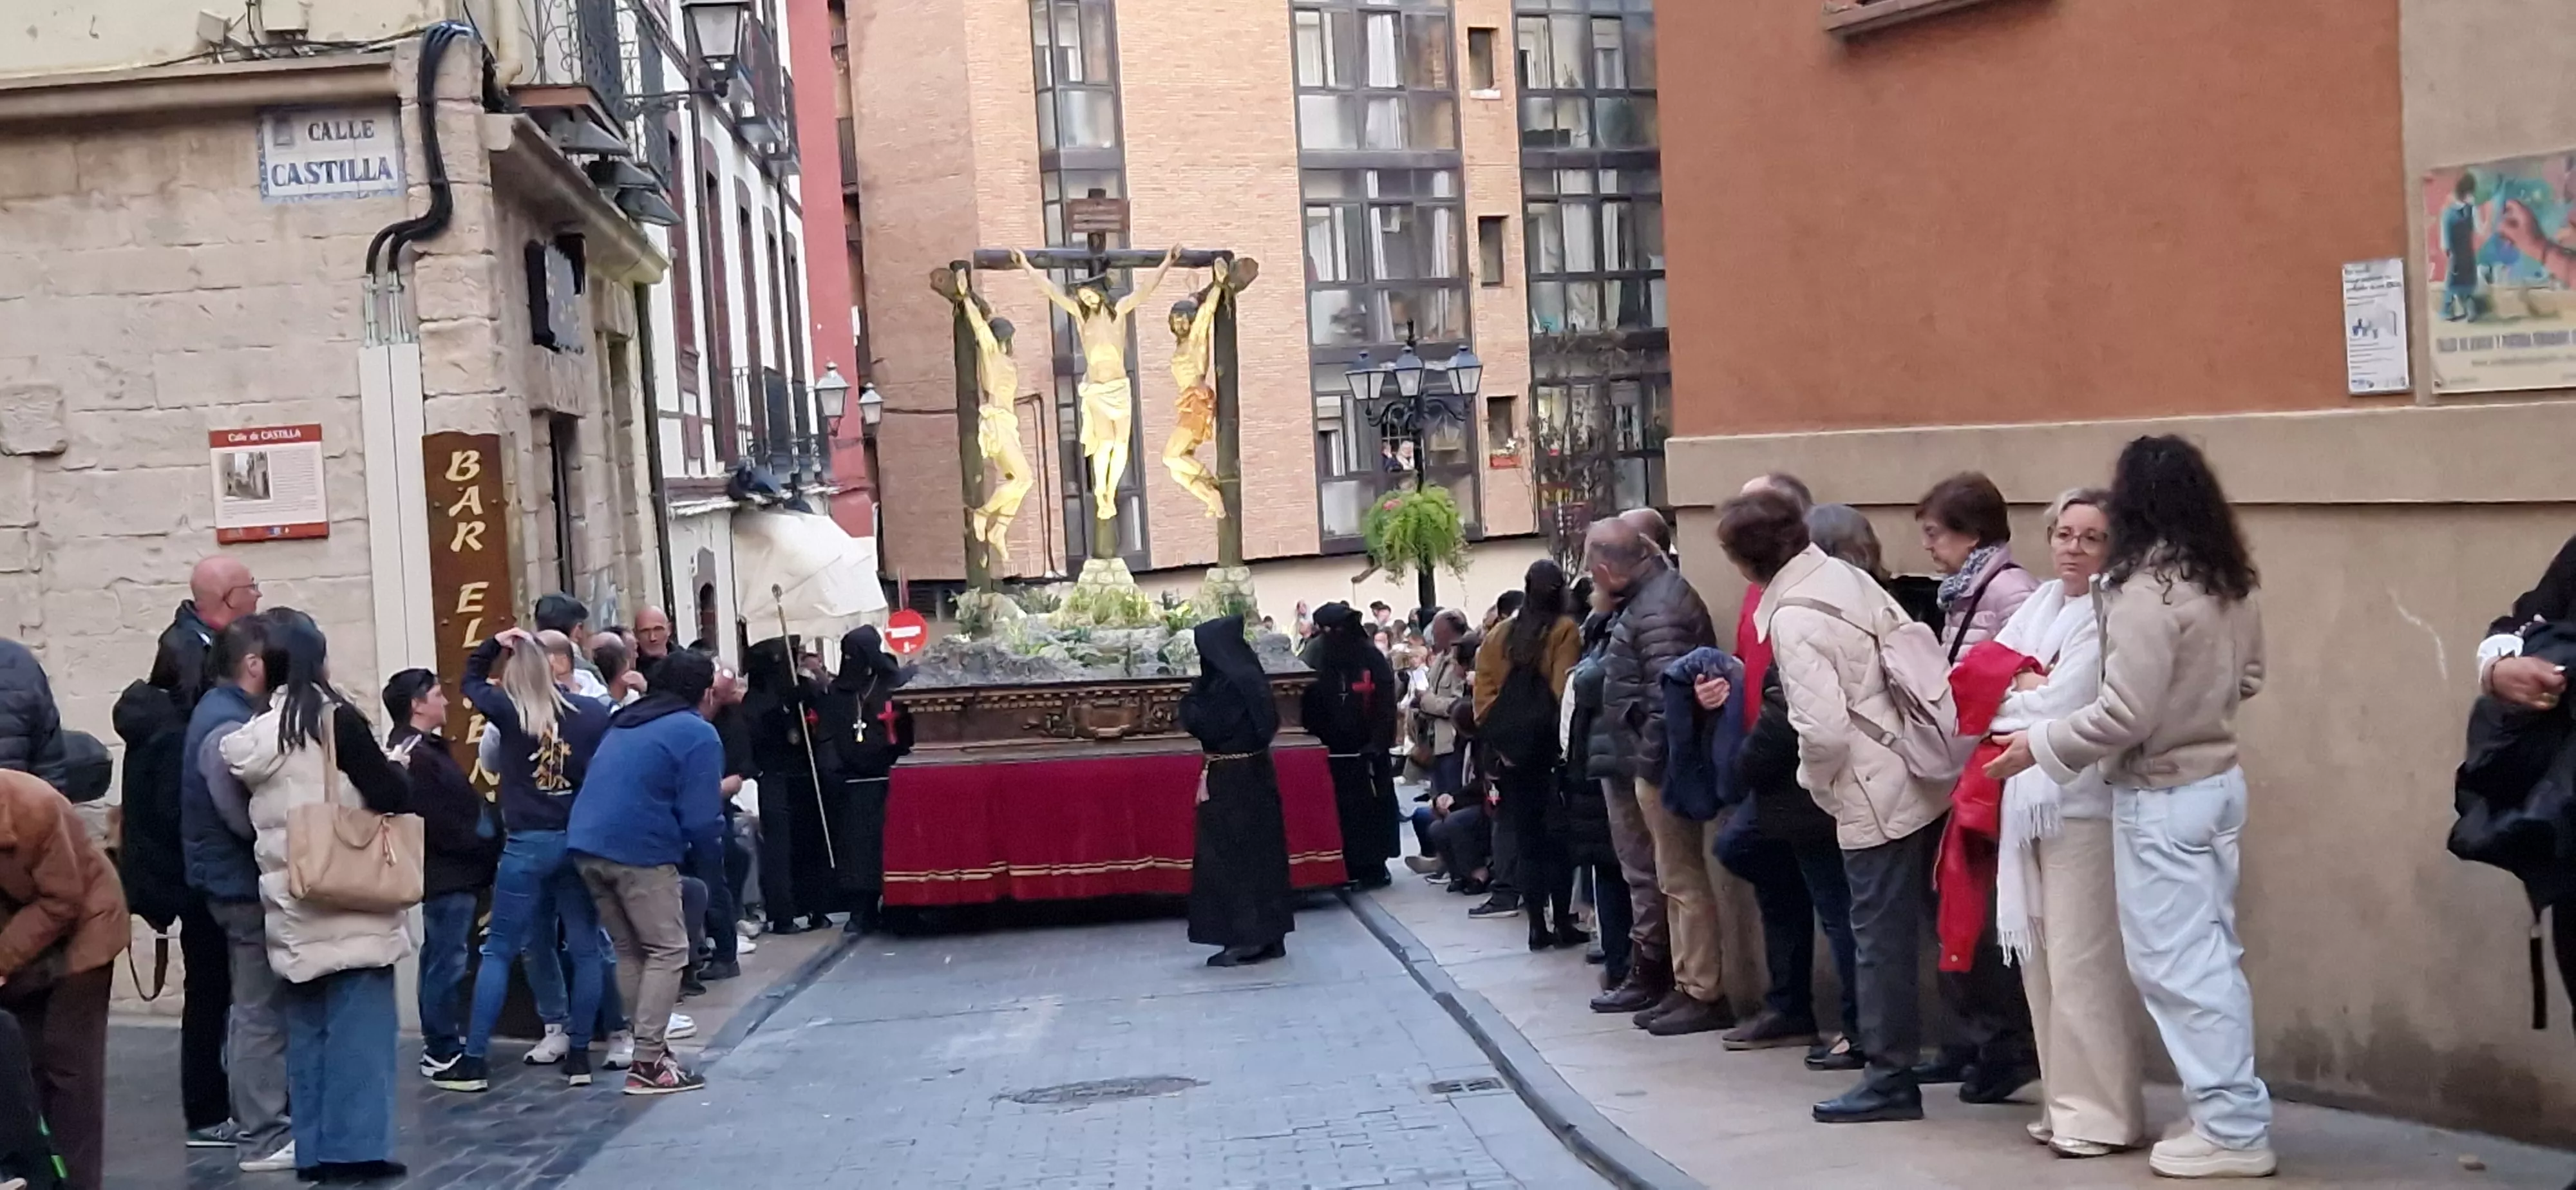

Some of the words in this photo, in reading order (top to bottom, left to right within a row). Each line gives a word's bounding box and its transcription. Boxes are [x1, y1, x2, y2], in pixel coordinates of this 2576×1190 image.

[308, 119, 375, 141] CALLE
[271, 156, 393, 187] CASTILLA
[261, 428, 301, 440] CASTILLA
[445, 450, 486, 552] BAR
[457, 581, 489, 648] EL
